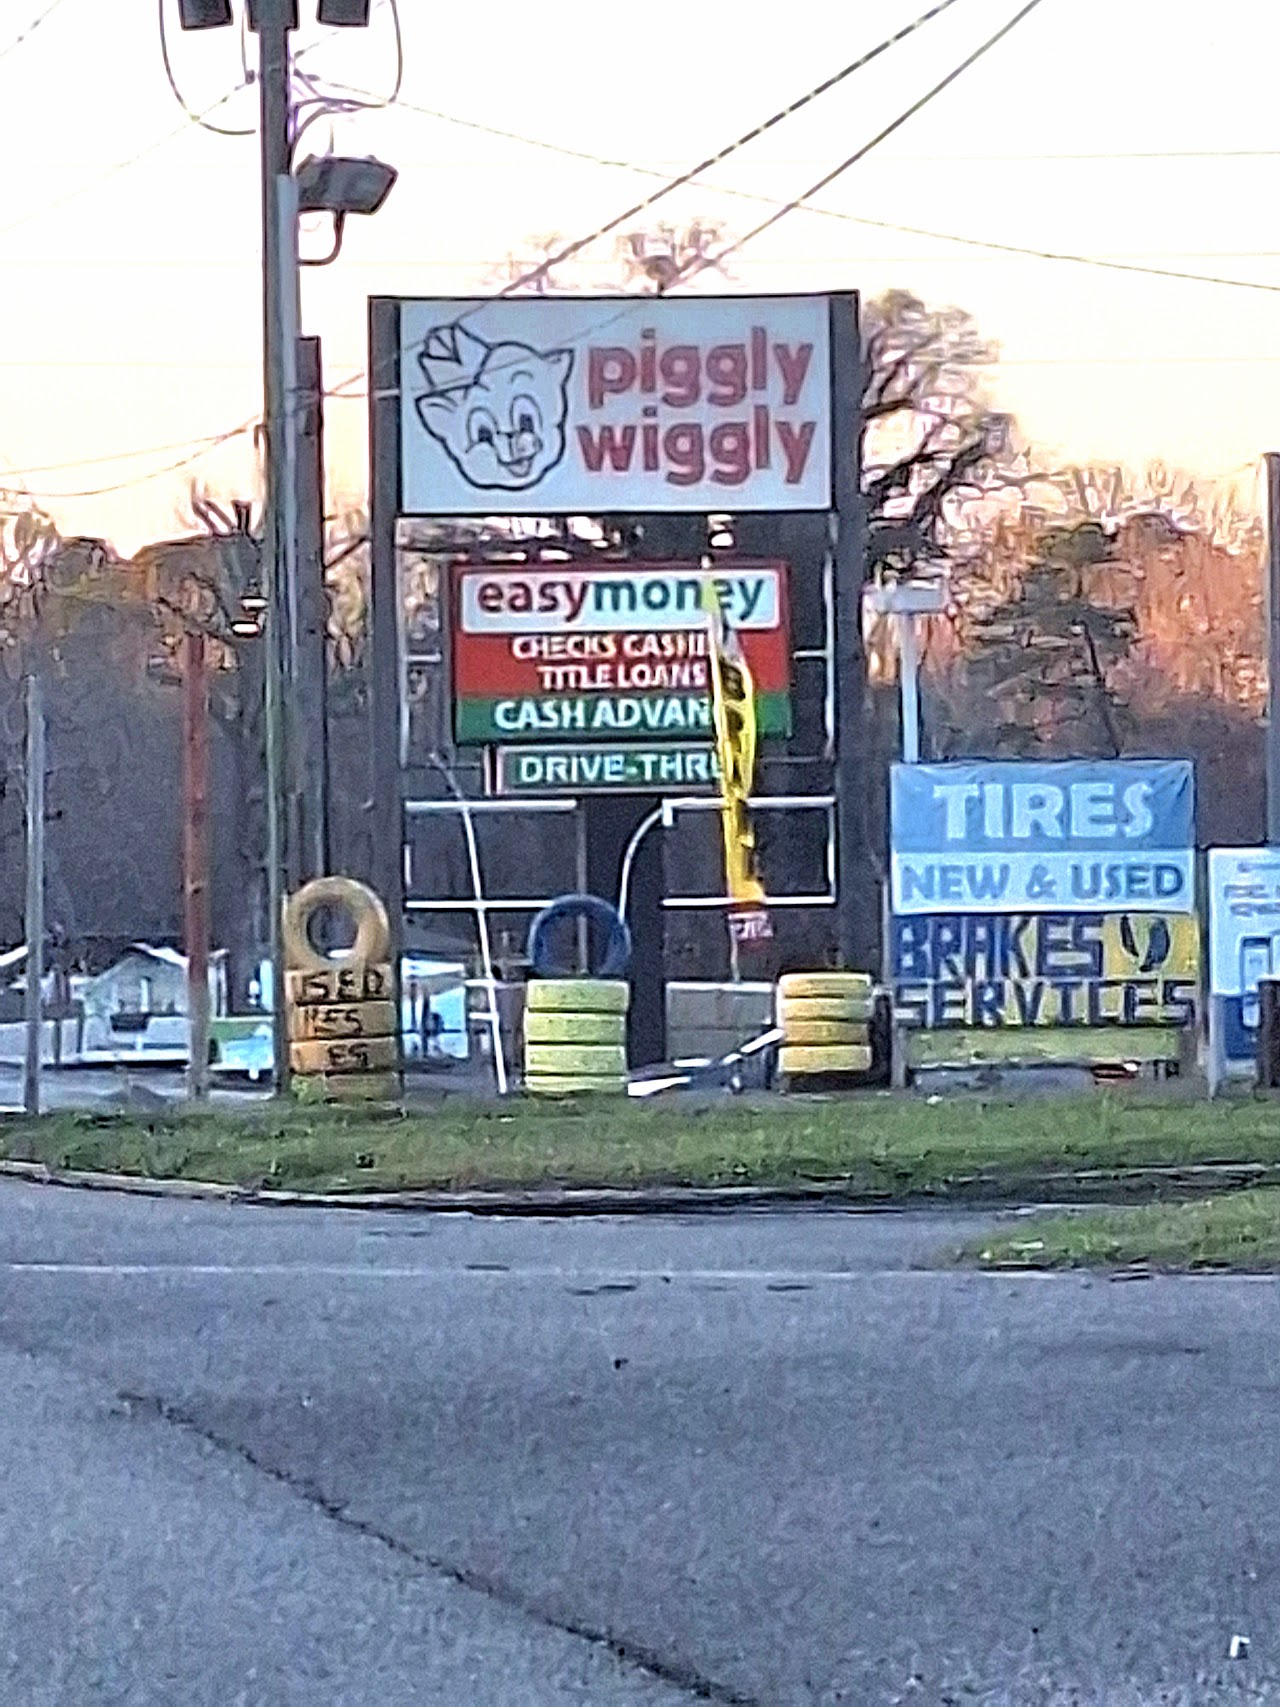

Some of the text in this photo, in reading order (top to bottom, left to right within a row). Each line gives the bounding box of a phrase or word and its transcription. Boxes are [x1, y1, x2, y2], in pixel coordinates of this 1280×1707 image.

[588, 327, 813, 409] piggly
[576, 406, 816, 485] wiggly
[478, 578, 764, 622] easymoney
[512, 634, 706, 660] CHECKS CASHI
[538, 663, 707, 690] TITLE LOANS
[495, 697, 711, 730] CASH ADVAN
[933, 782, 1154, 841] TIRES
[903, 863, 1184, 899] NEW & USED
[890, 914, 1103, 983] BRAKES
